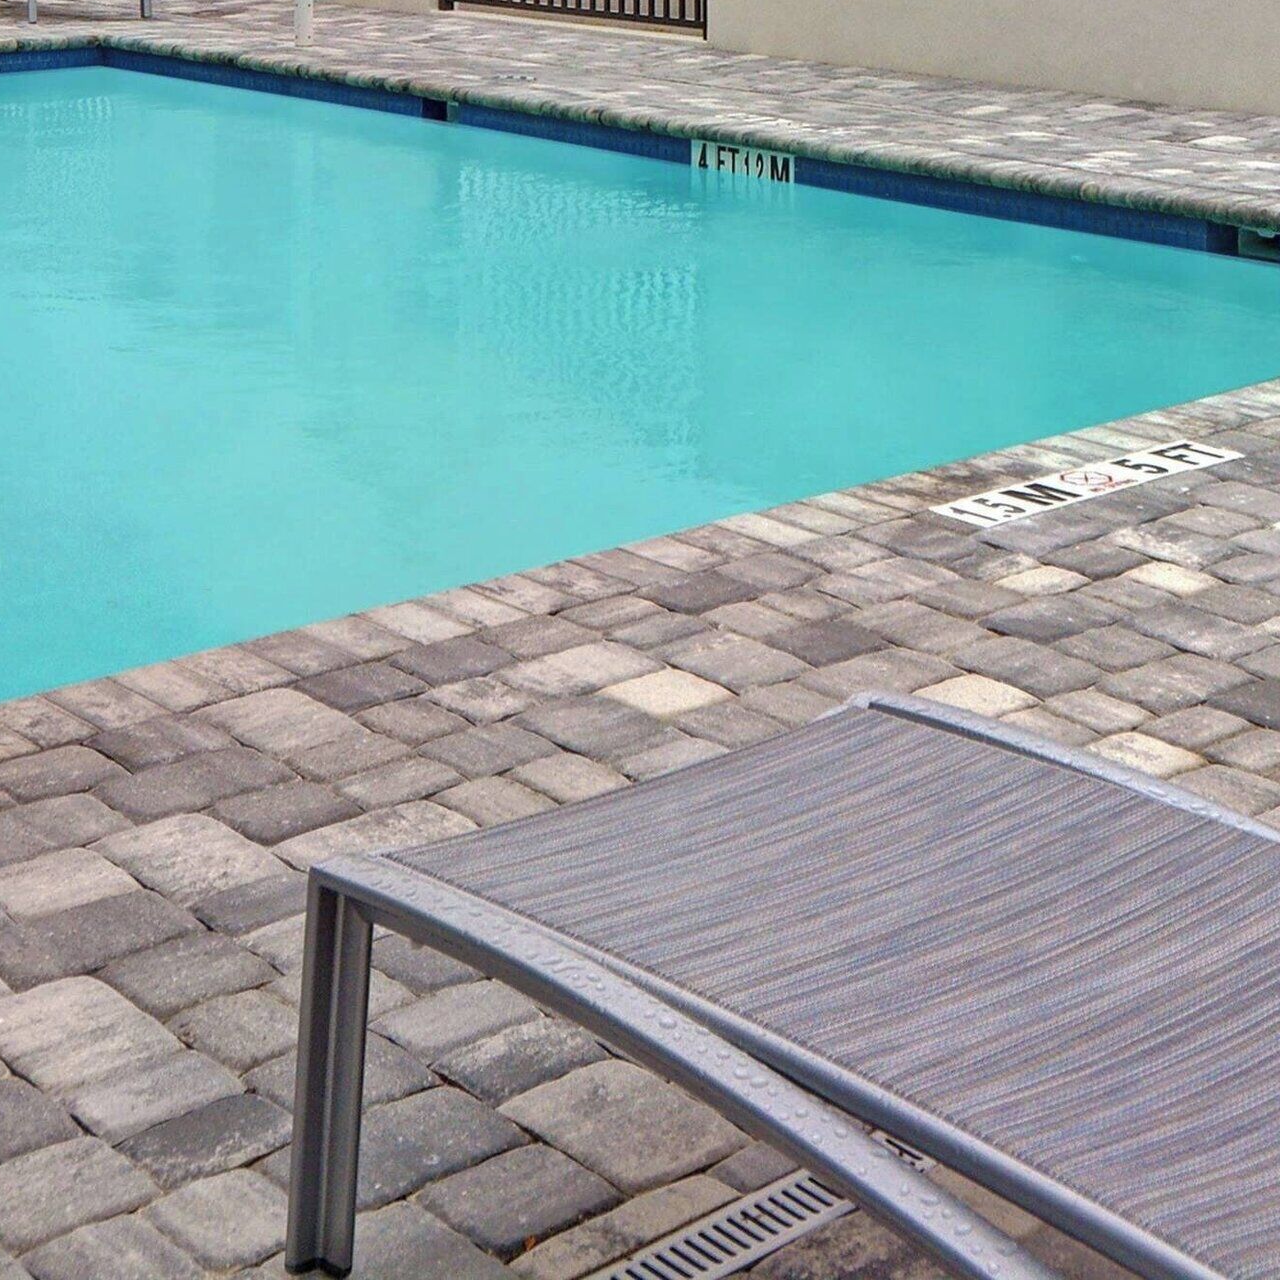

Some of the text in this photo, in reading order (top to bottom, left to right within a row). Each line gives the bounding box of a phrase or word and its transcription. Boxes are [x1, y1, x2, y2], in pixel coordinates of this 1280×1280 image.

[698, 142, 709, 169] 4
[716, 145, 740, 173] FT
[770, 155, 790, 184] M
[948, 497, 1027, 522] 1.5
[998, 482, 1084, 506] M
[1109, 458, 1170, 475] 5
[1147, 442, 1226, 466] FT
